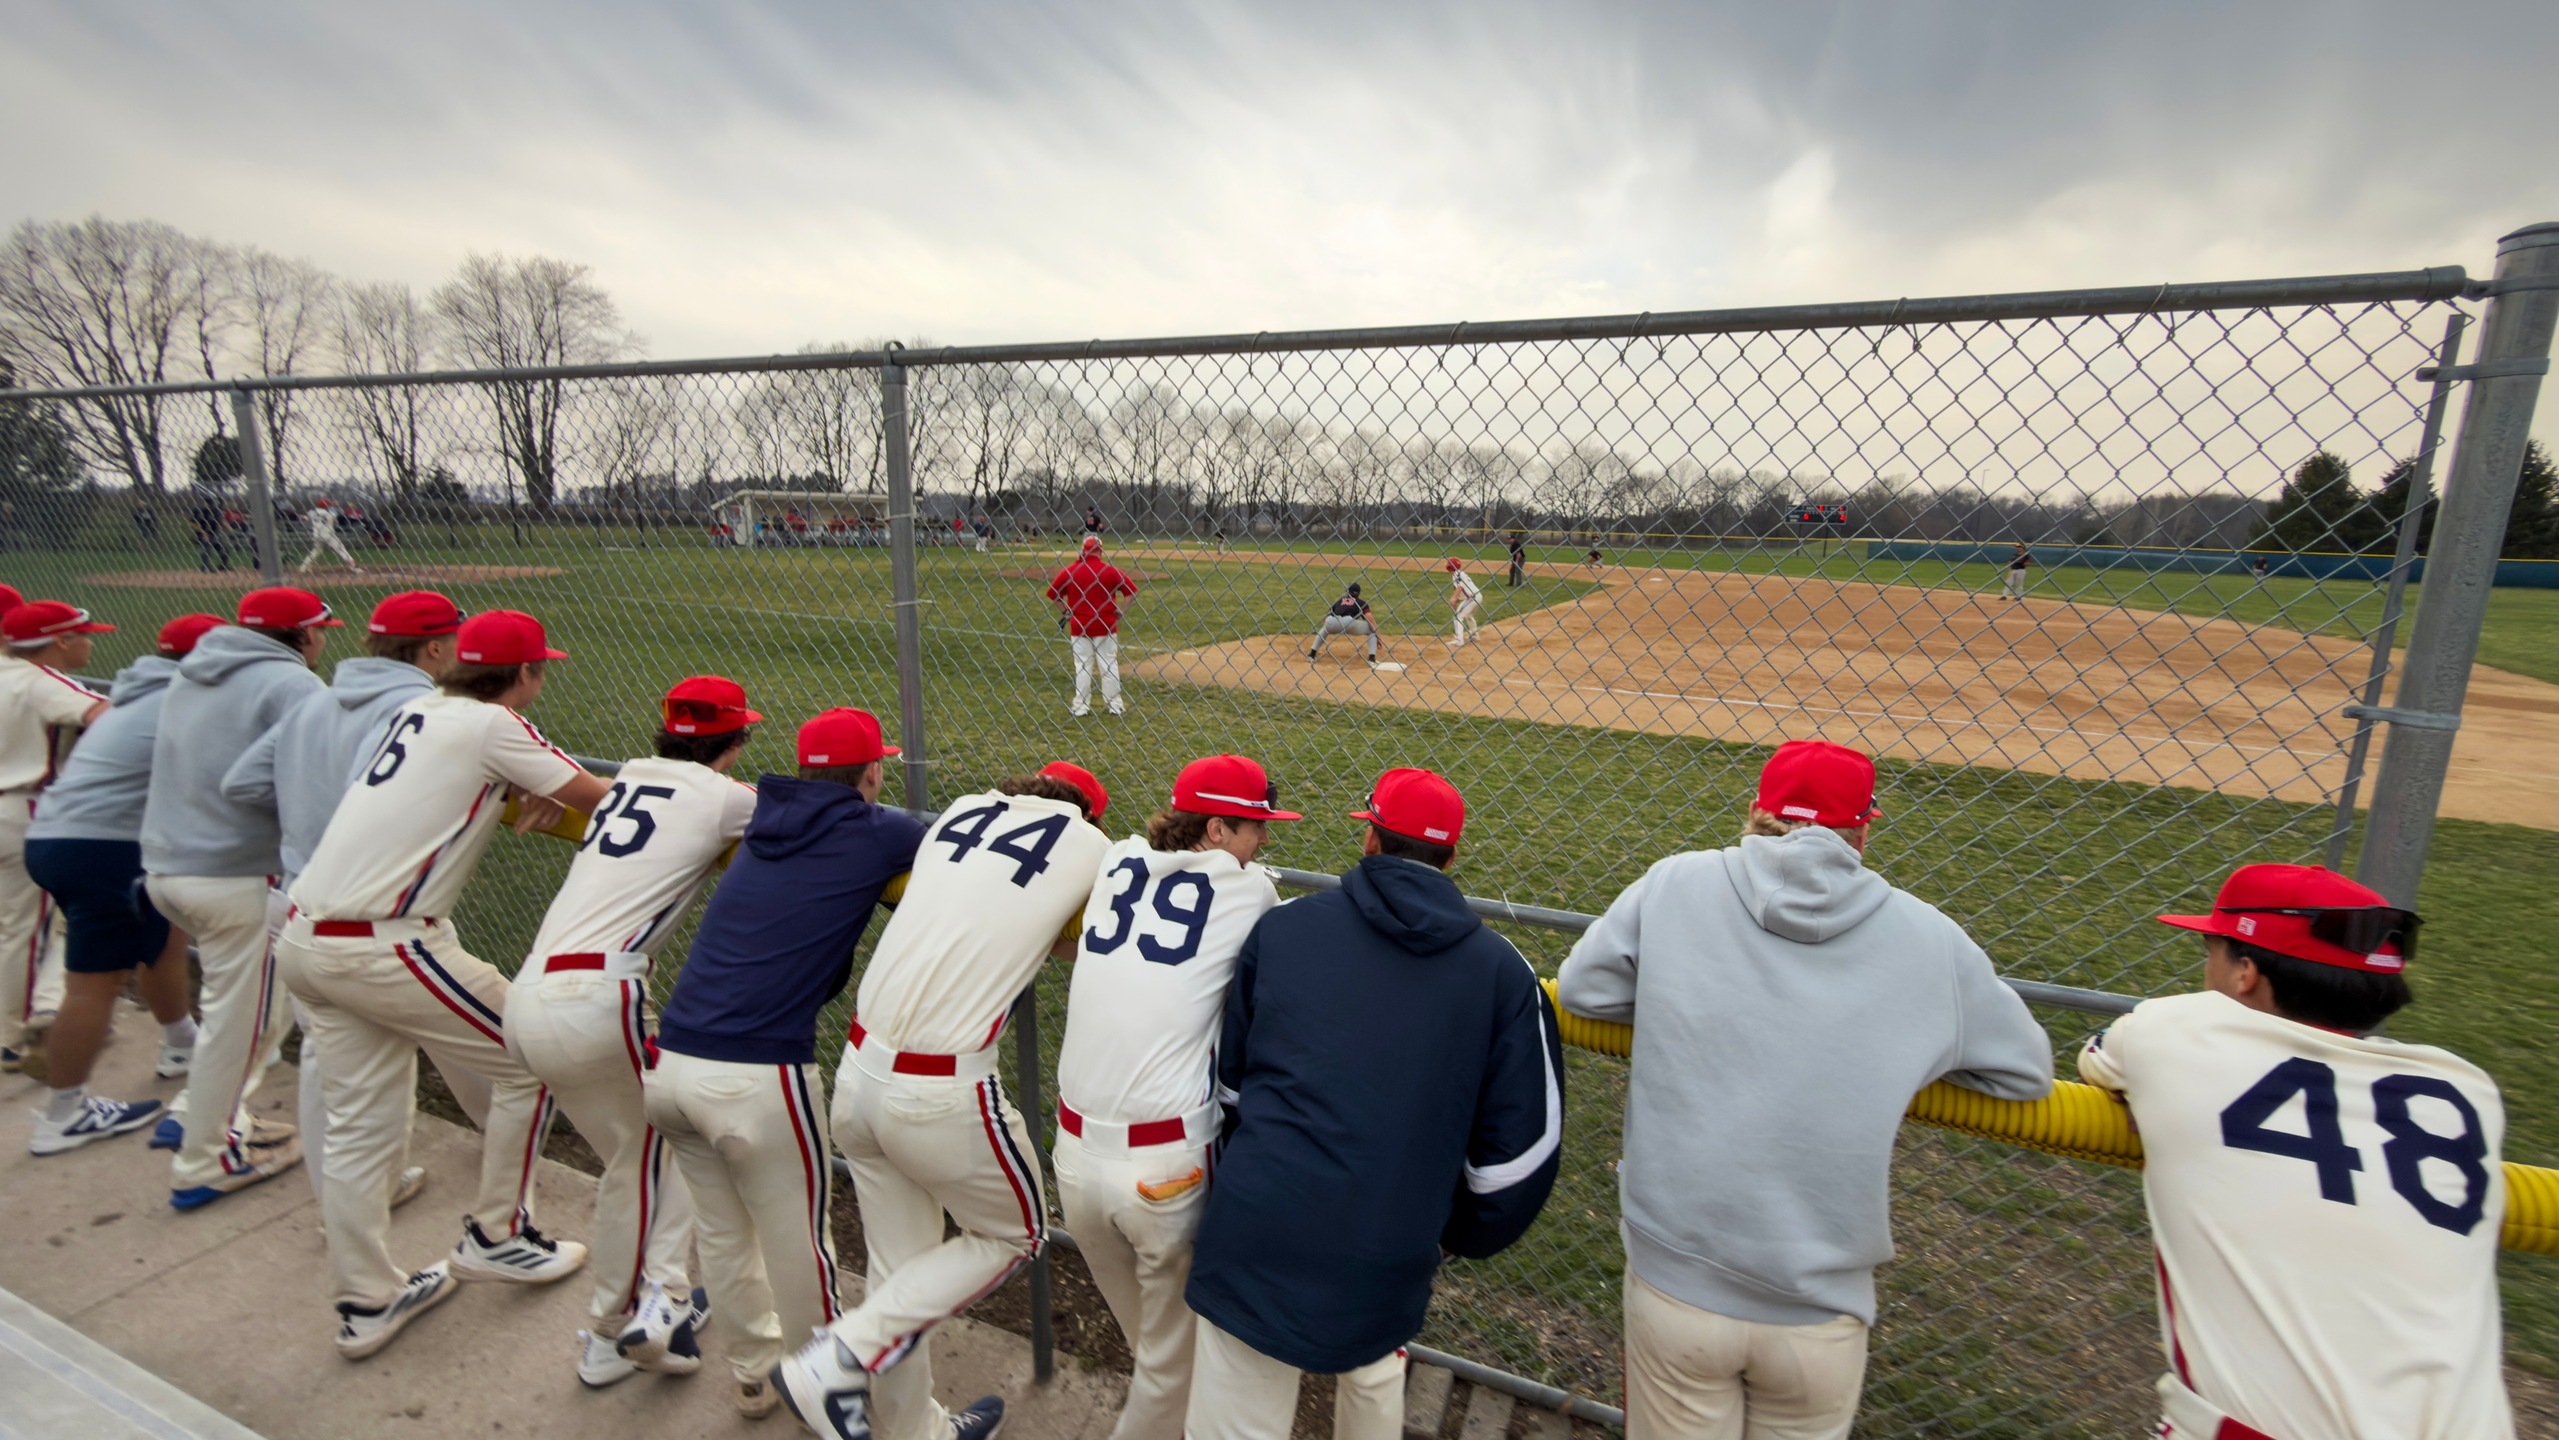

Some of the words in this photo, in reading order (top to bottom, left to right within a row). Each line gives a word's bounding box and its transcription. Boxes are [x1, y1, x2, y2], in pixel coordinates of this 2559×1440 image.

[579, 782, 676, 858] 35
[935, 801, 1071, 888] 44
[1085, 857, 1215, 966] 39
[2220, 1056, 2490, 1237] 48
